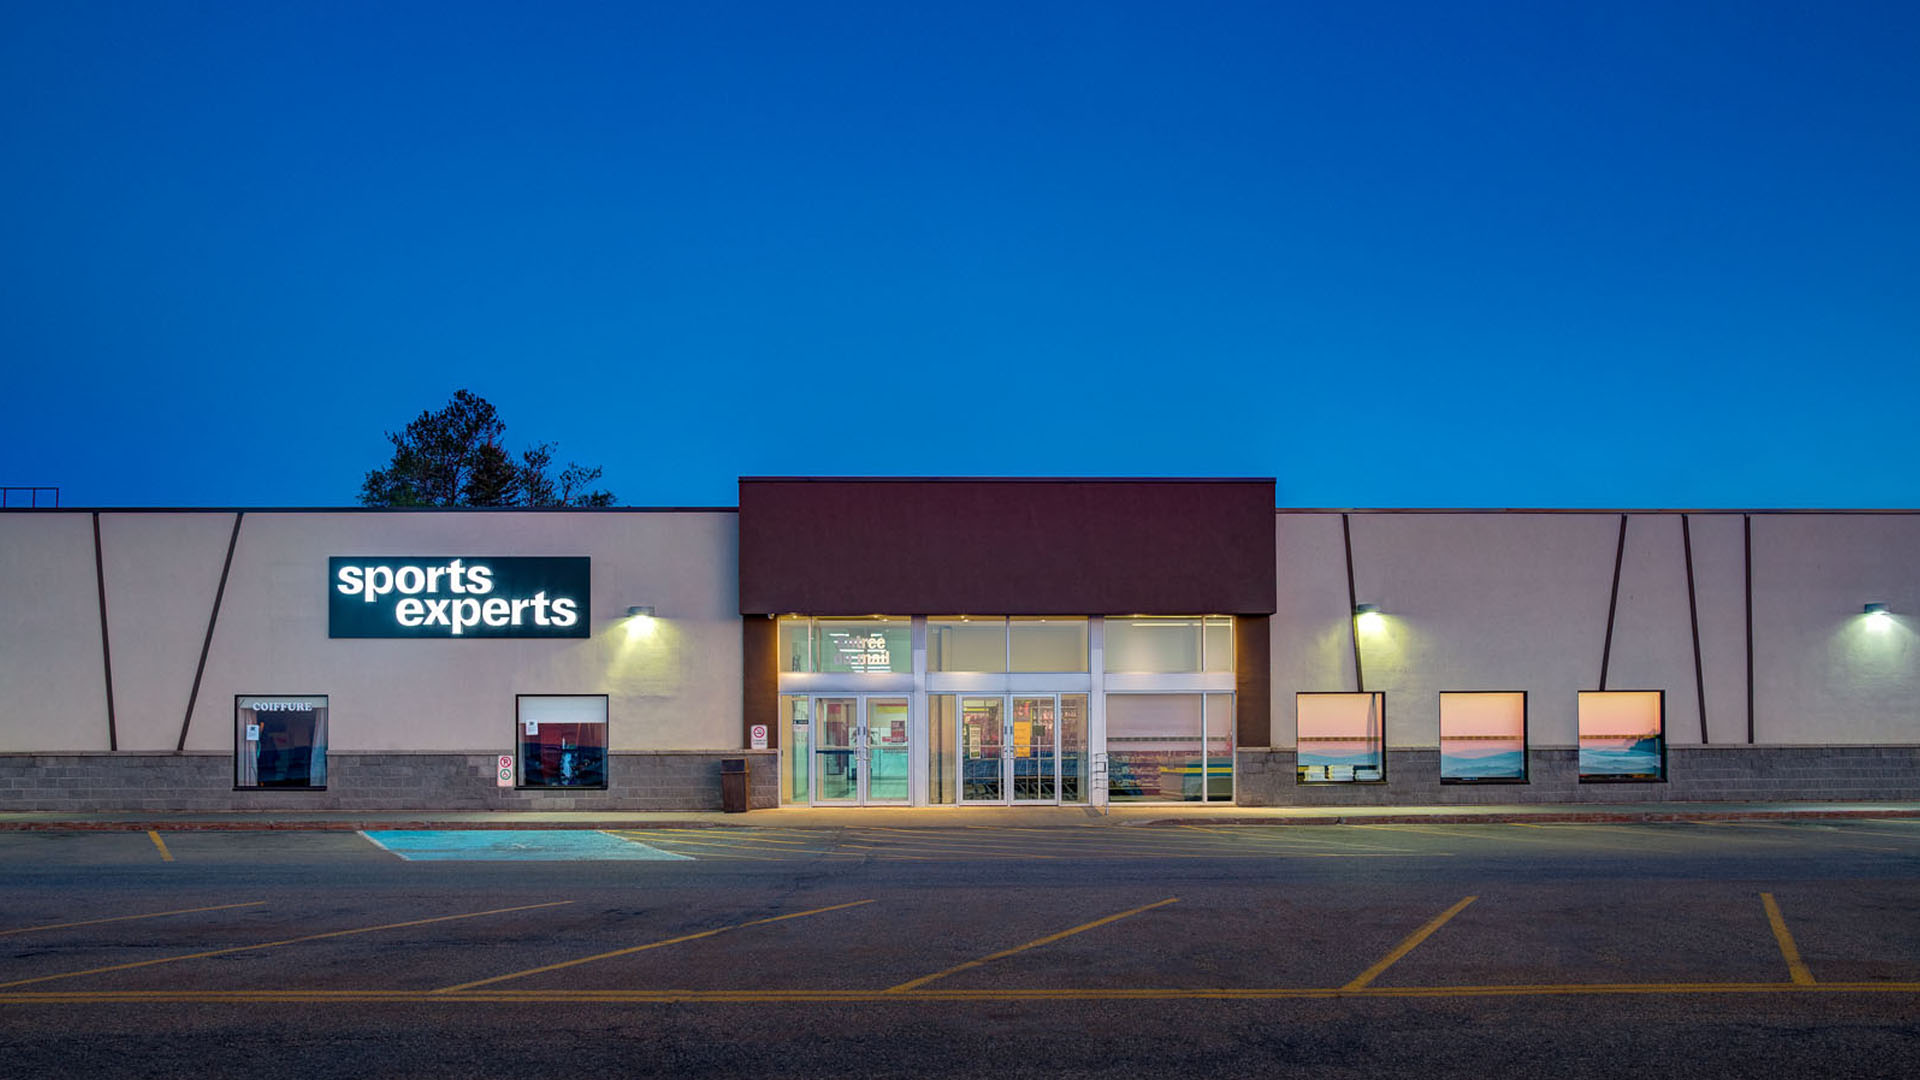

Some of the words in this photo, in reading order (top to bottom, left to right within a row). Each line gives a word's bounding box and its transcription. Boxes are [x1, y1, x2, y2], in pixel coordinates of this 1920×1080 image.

[337, 558, 494, 602] sports
[395, 590, 578, 634] experts
[252, 702, 313, 712] COIFFURE
